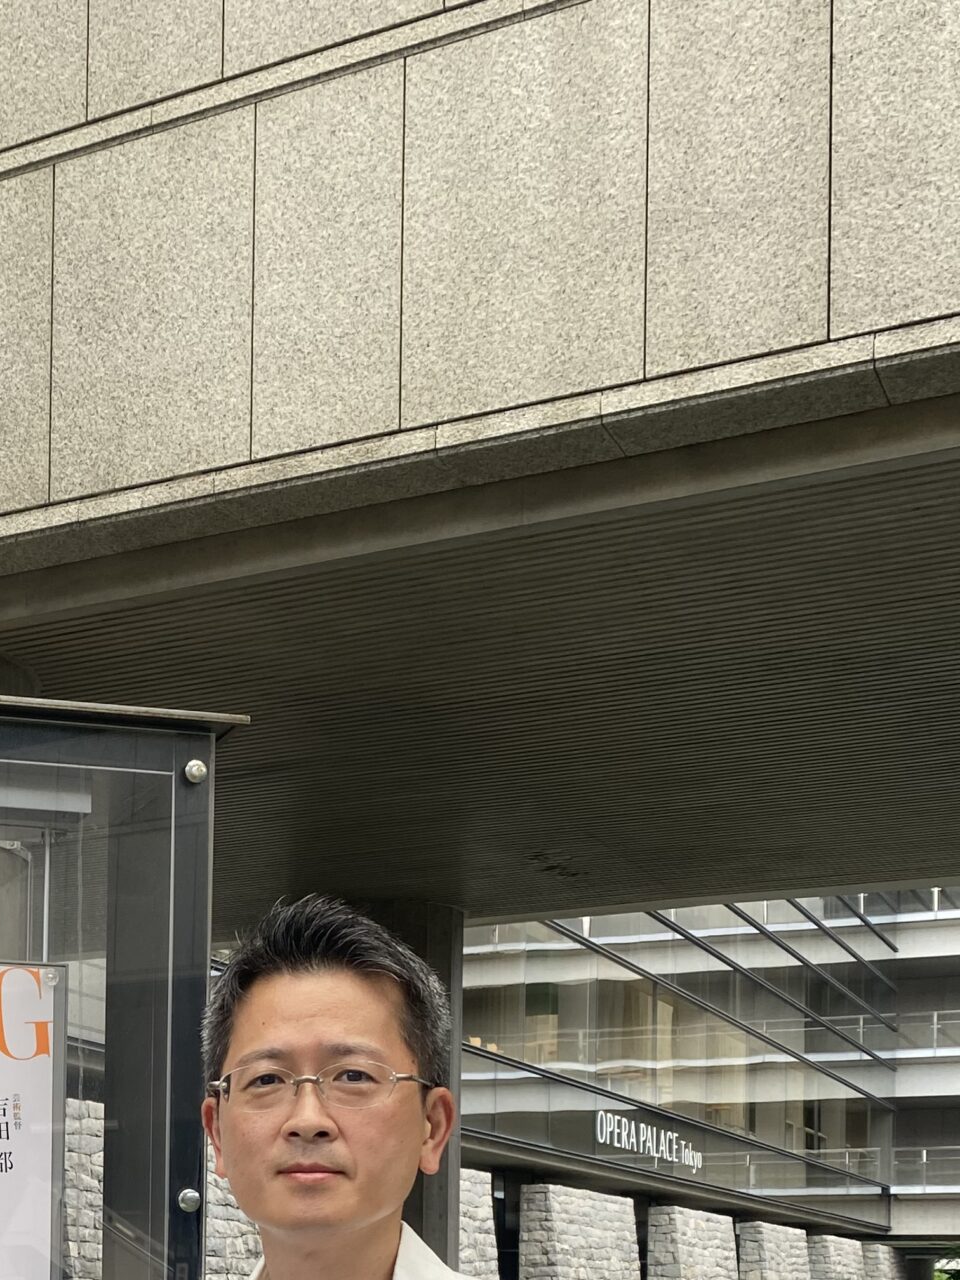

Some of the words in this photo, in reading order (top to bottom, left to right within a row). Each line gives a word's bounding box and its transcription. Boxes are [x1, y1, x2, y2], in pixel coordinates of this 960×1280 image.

[597, 1110, 637, 1152] OPERA
[639, 1122, 679, 1163] PALACE
[680, 1140, 703, 1174] Tokyo
